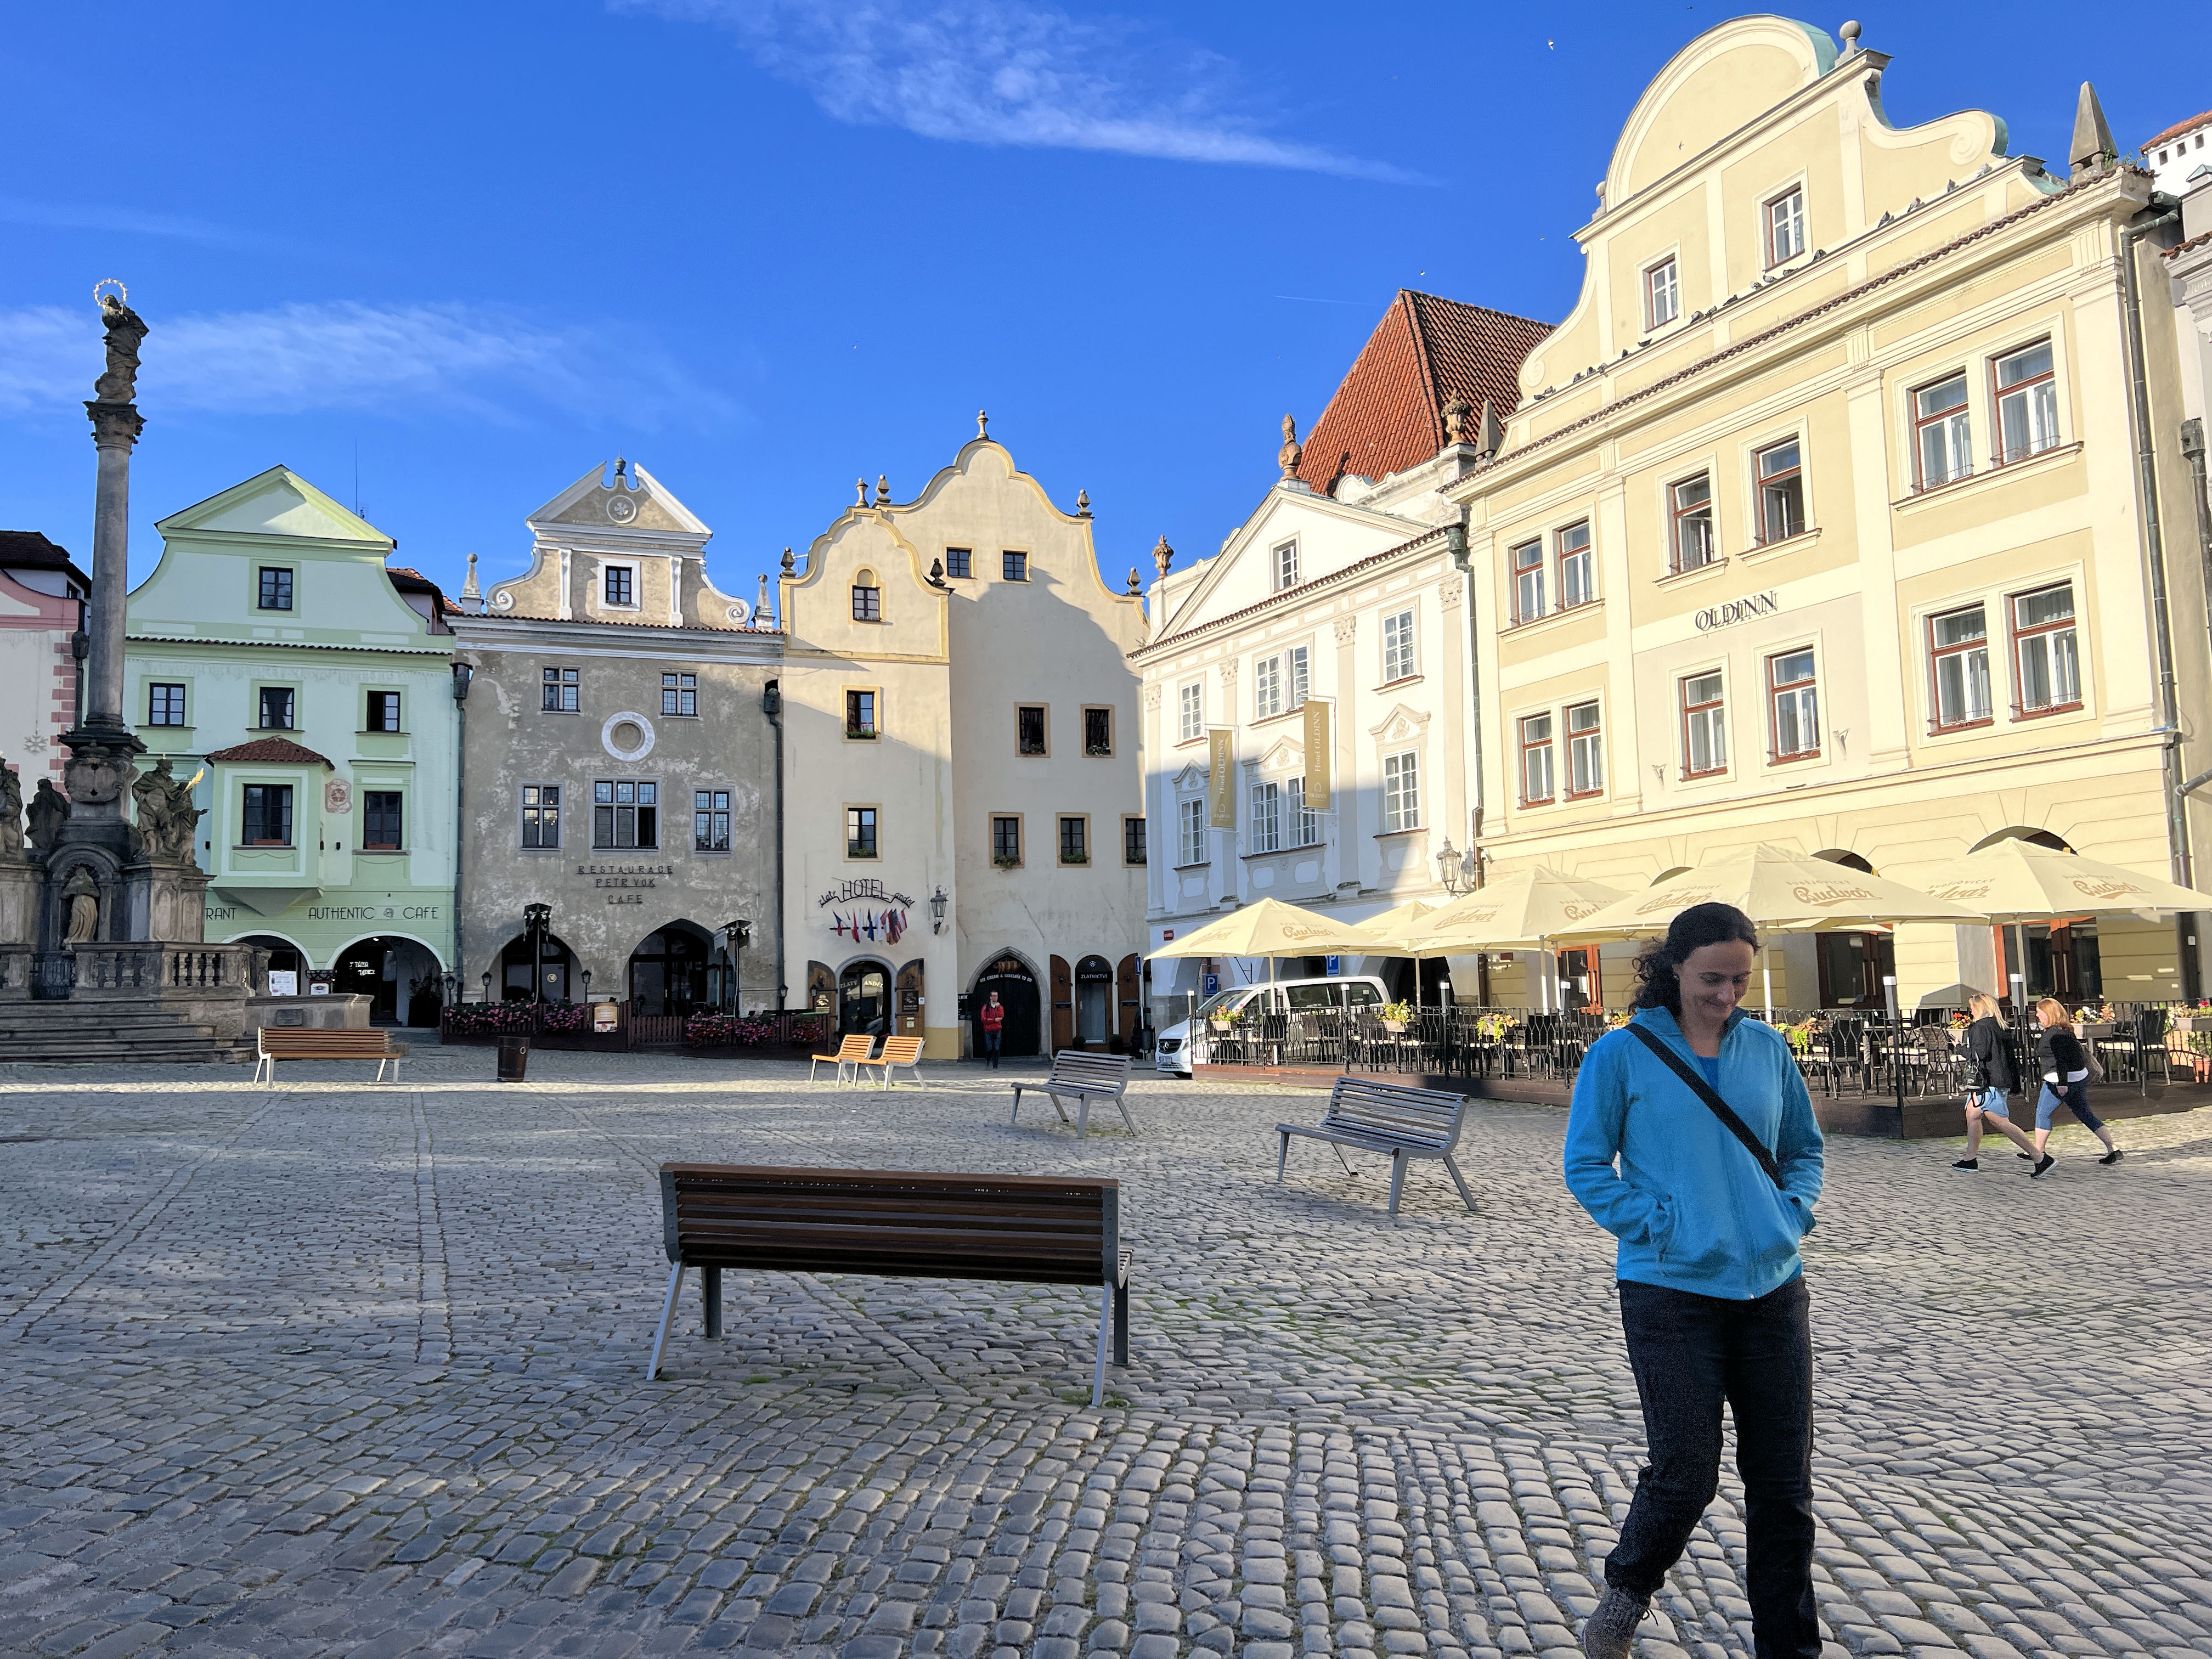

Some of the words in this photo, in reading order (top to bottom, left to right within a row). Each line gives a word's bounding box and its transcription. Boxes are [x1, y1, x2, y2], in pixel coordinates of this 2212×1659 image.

[1695, 590, 1778, 631] OLDINN
[1313, 711, 1321, 749] OLDINN
[578, 865, 673, 874] RESTAURACE
[596, 878, 628, 888] PETR
[633, 878, 656, 888] VOK
[842, 878, 889, 901] HOTEL
[608, 894, 643, 904] CAFE
[1793, 885, 1884, 907] Budvar
[205, 907, 237, 920] RANT
[308, 907, 375, 919] AUTHENTIC
[403, 907, 439, 919] CAFE
[1283, 926, 1341, 940] Budvar
[1329, 956, 1336, 967] P
[1207, 977, 1215, 989] P
